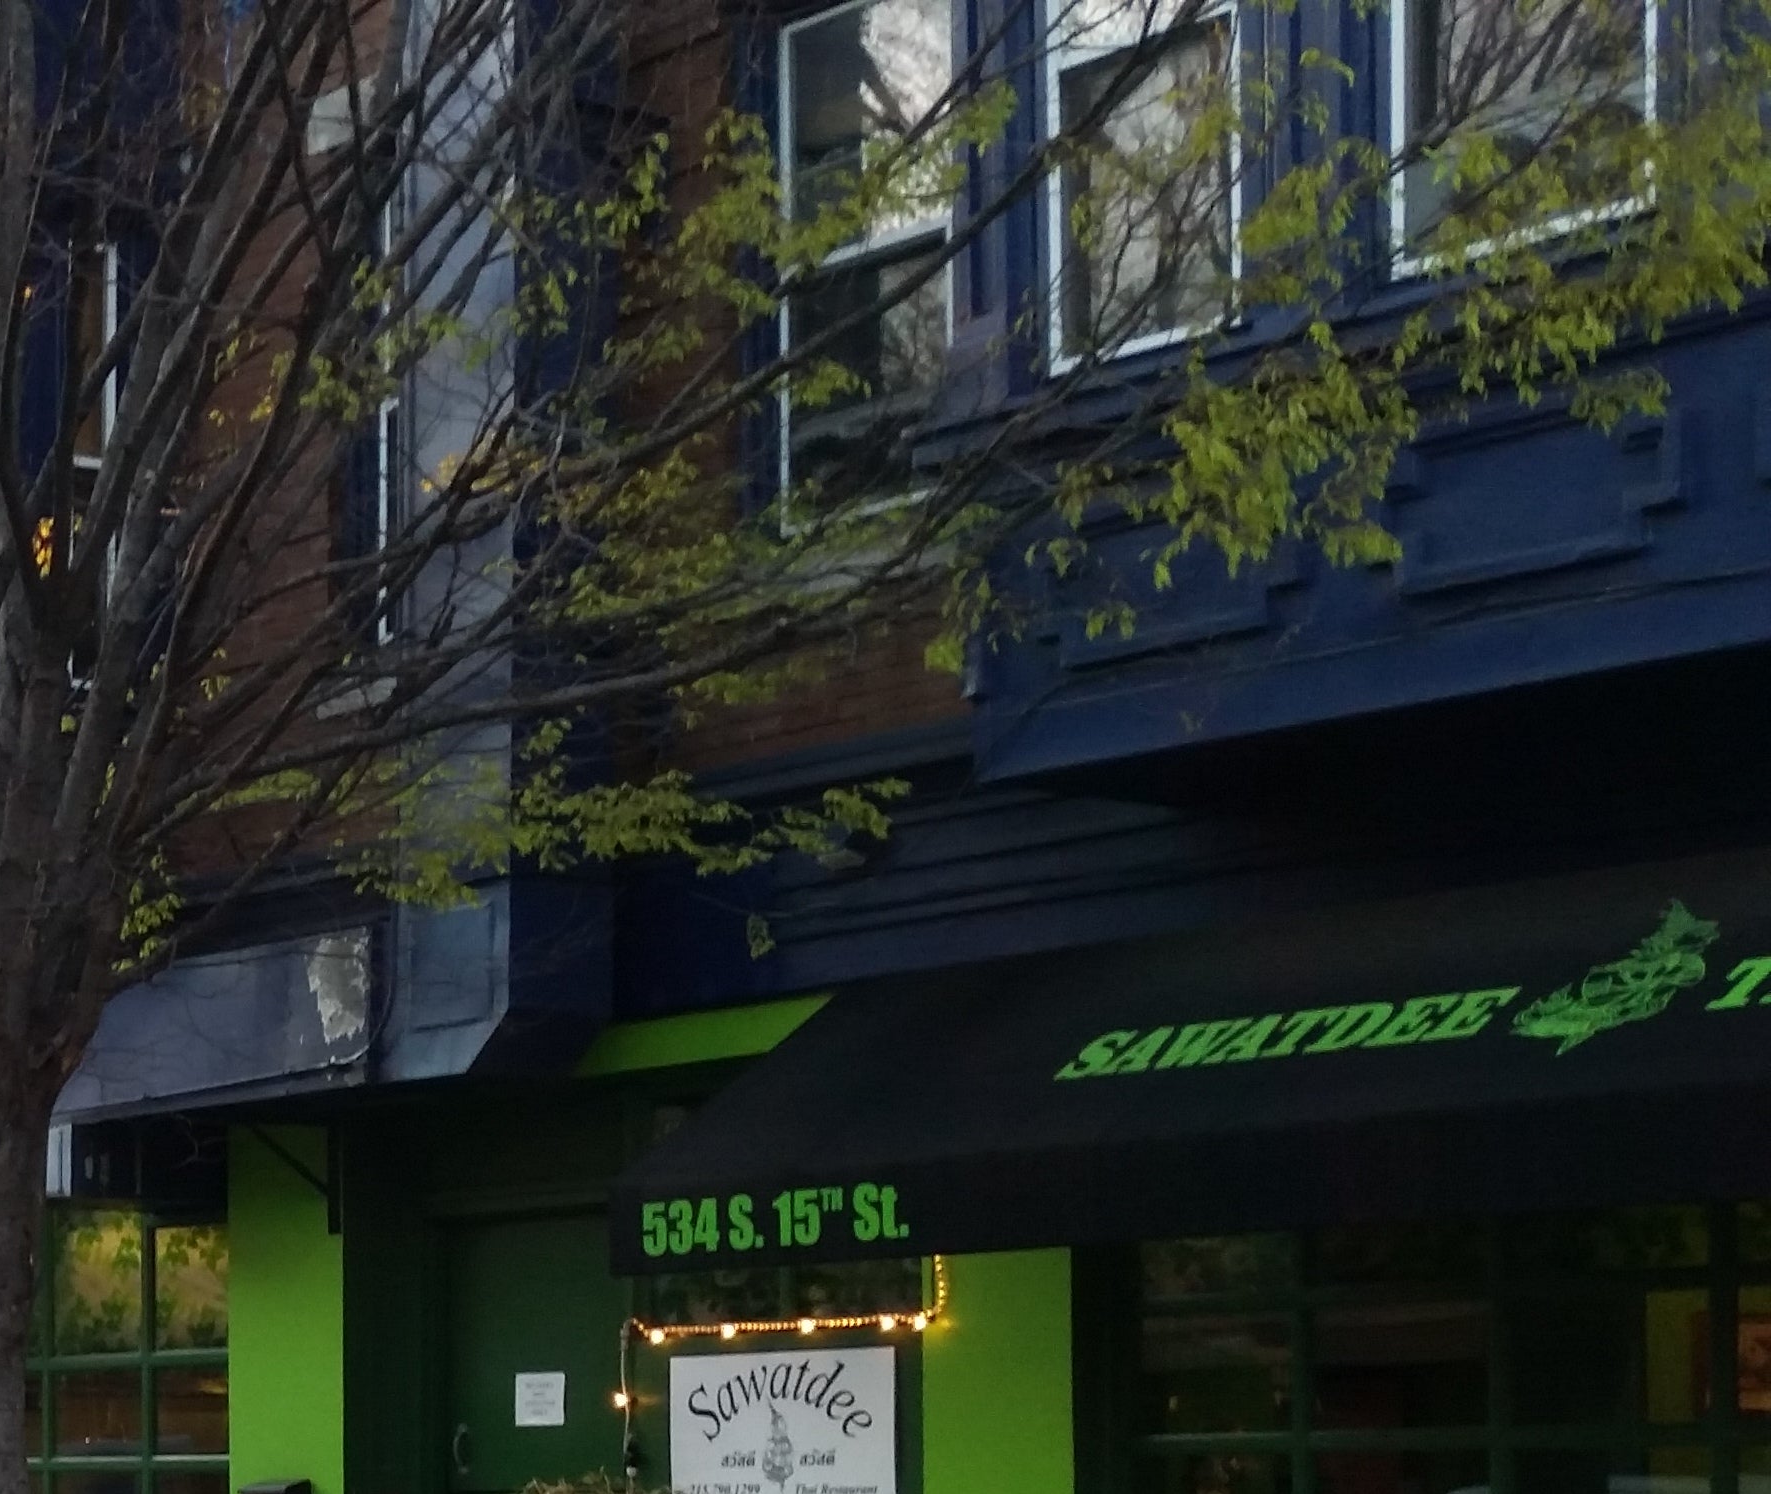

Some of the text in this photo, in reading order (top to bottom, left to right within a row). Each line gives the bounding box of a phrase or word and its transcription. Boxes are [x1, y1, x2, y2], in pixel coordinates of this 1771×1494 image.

[1054, 956, 1771, 1081] SAWATDEE T
[642, 1198, 720, 1257] 534
[727, 1193, 764, 1250] S.
[853, 1182, 909, 1242] St.
[687, 1358, 873, 1442] Sawatdee
